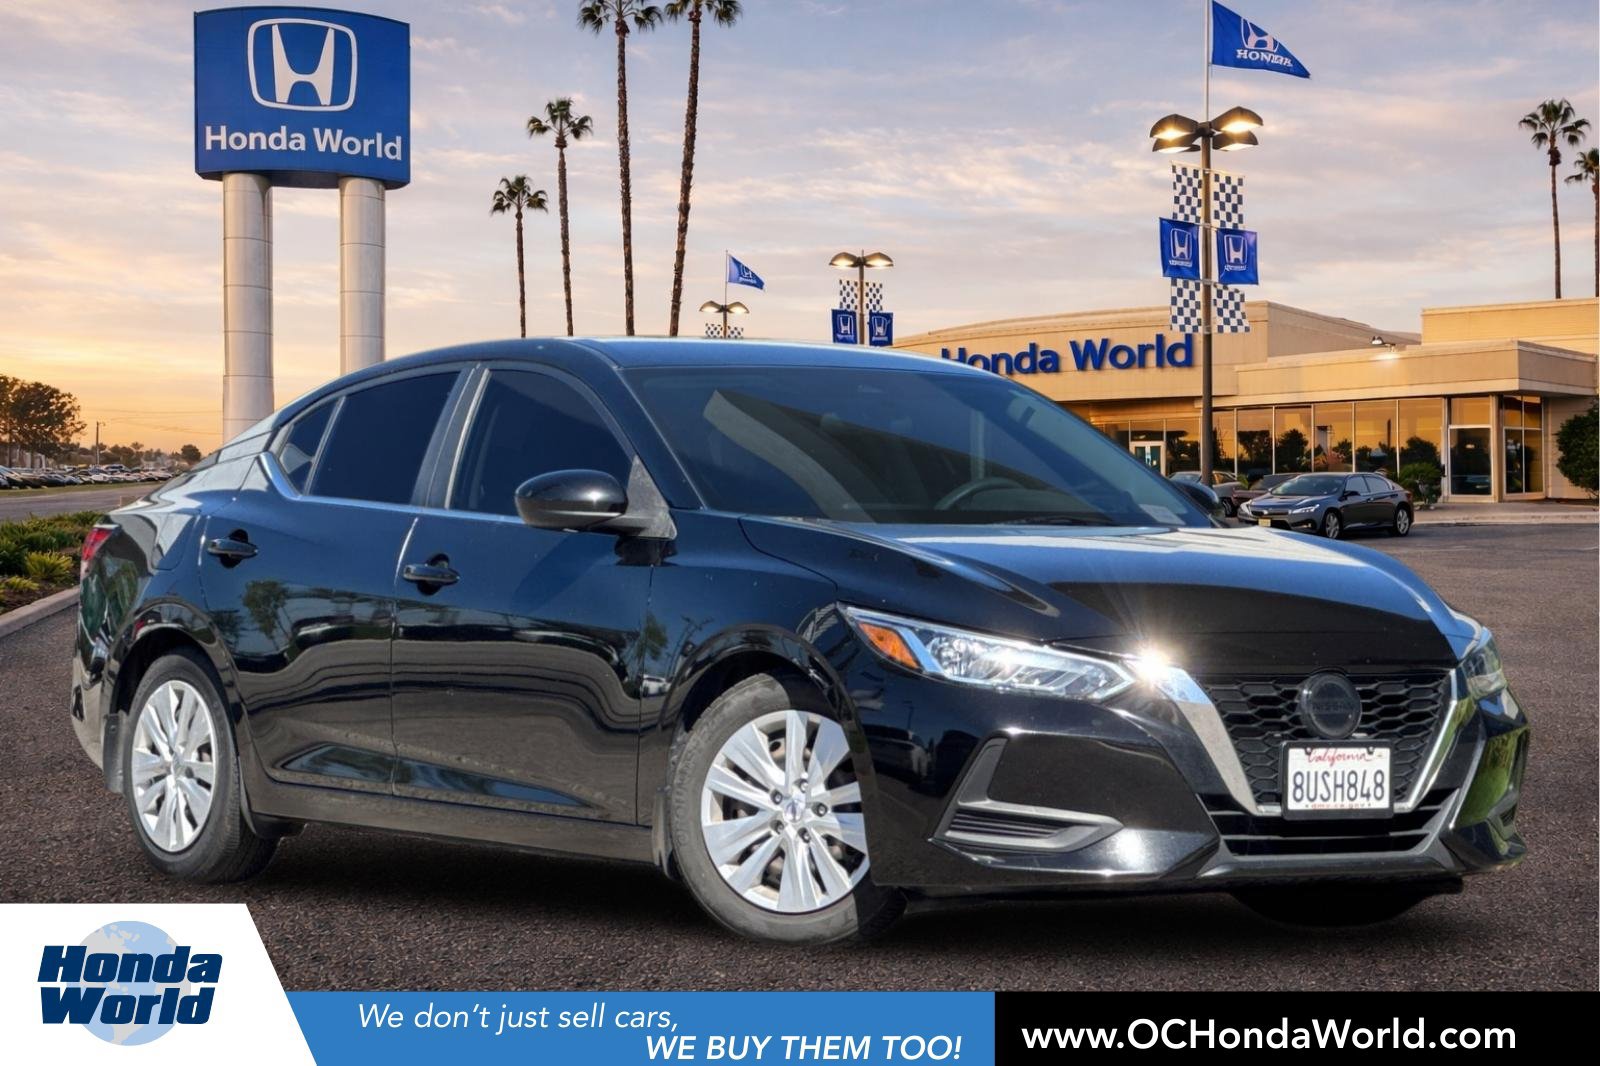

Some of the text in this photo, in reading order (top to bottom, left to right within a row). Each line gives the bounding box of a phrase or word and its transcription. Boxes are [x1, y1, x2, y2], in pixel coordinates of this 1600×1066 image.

[205, 125, 402, 161] Honda World
[1069, 333, 1194, 371] World
[1308, 748, 1372, 767] California
[1293, 769, 1385, 803] 8USH848
